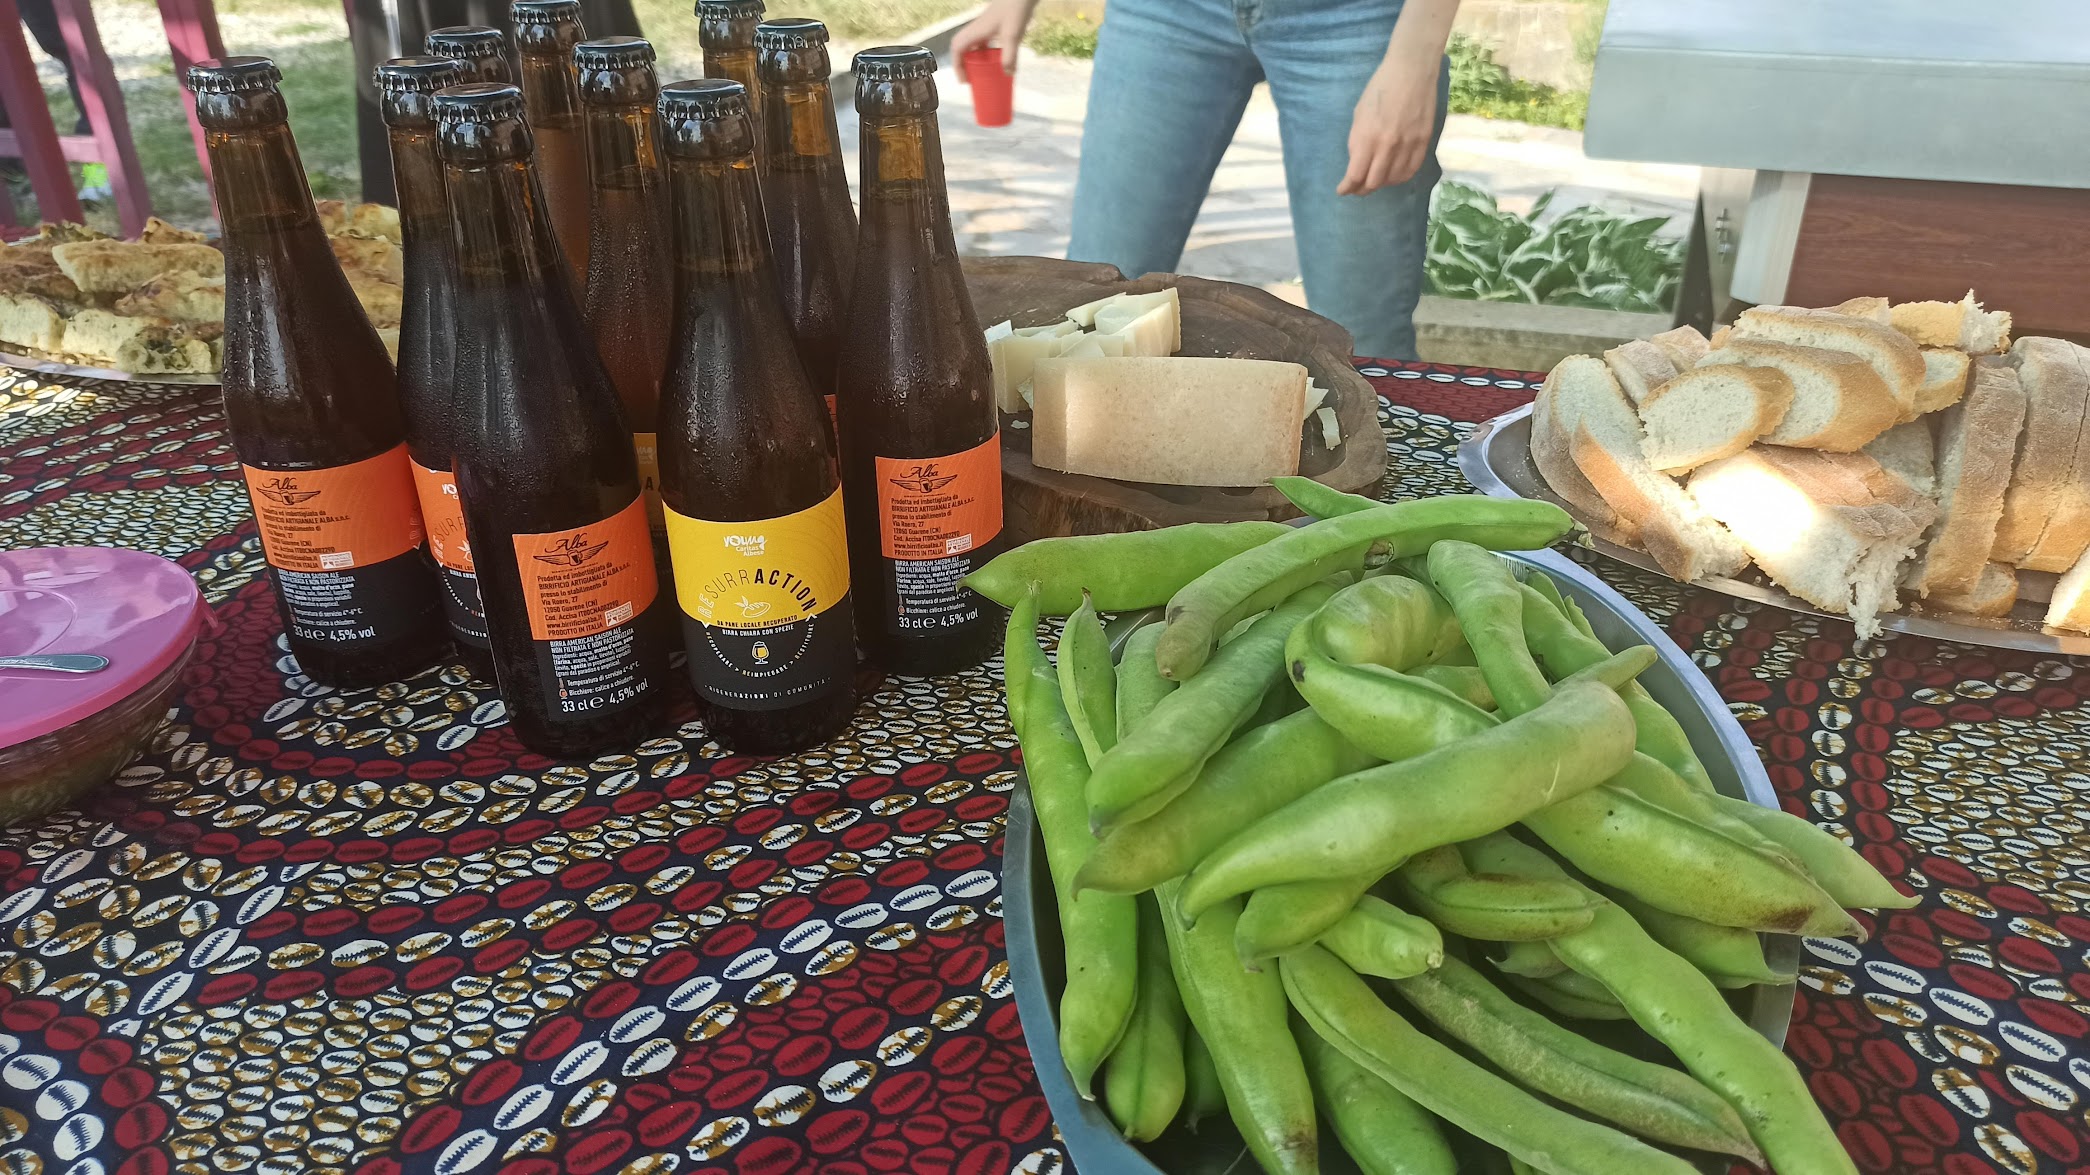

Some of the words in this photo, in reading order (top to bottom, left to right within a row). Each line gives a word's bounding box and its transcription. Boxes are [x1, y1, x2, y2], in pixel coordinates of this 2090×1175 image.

[900, 464, 939, 478] Alba
[262, 477, 297, 490] Alba
[919, 502, 950, 512] ARTIGIANALE
[545, 533, 587, 553] Alba
[928, 548, 943, 556] ITALIA
[539, 582, 569, 590] BIRRIFICIO
[571, 572, 605, 586] ARTIGIANALE
[607, 567, 619, 576] ALBA
[572, 566, 605, 578] imbottigliata
[568, 583, 601, 595] stabilimento
[562, 602, 584, 612] Guarene
[586, 599, 598, 608] (CN)
[764, 615, 798, 626] RECUPERATO
[899, 617, 910, 628] 33
[913, 618, 921, 628] cl
[941, 613, 964, 627] 4,5%
[966, 608, 978, 620] vol
[293, 625, 303, 636] 33
[330, 629, 356, 641] 4,5%
[359, 626, 376, 638] vol
[548, 627, 577, 636] PRODOTTO
[586, 622, 603, 631] ITALIA
[775, 624, 794, 634] SPEZIE
[567, 637, 593, 645] AMERICAN
[595, 632, 612, 642] SAISON
[613, 627, 621, 636] ALE
[564, 644, 586, 652] FILTRATA
[562, 701, 575, 712] 33
[578, 699, 588, 710] cl
[610, 687, 634, 704] 4,5%
[636, 678, 648, 693] vol
